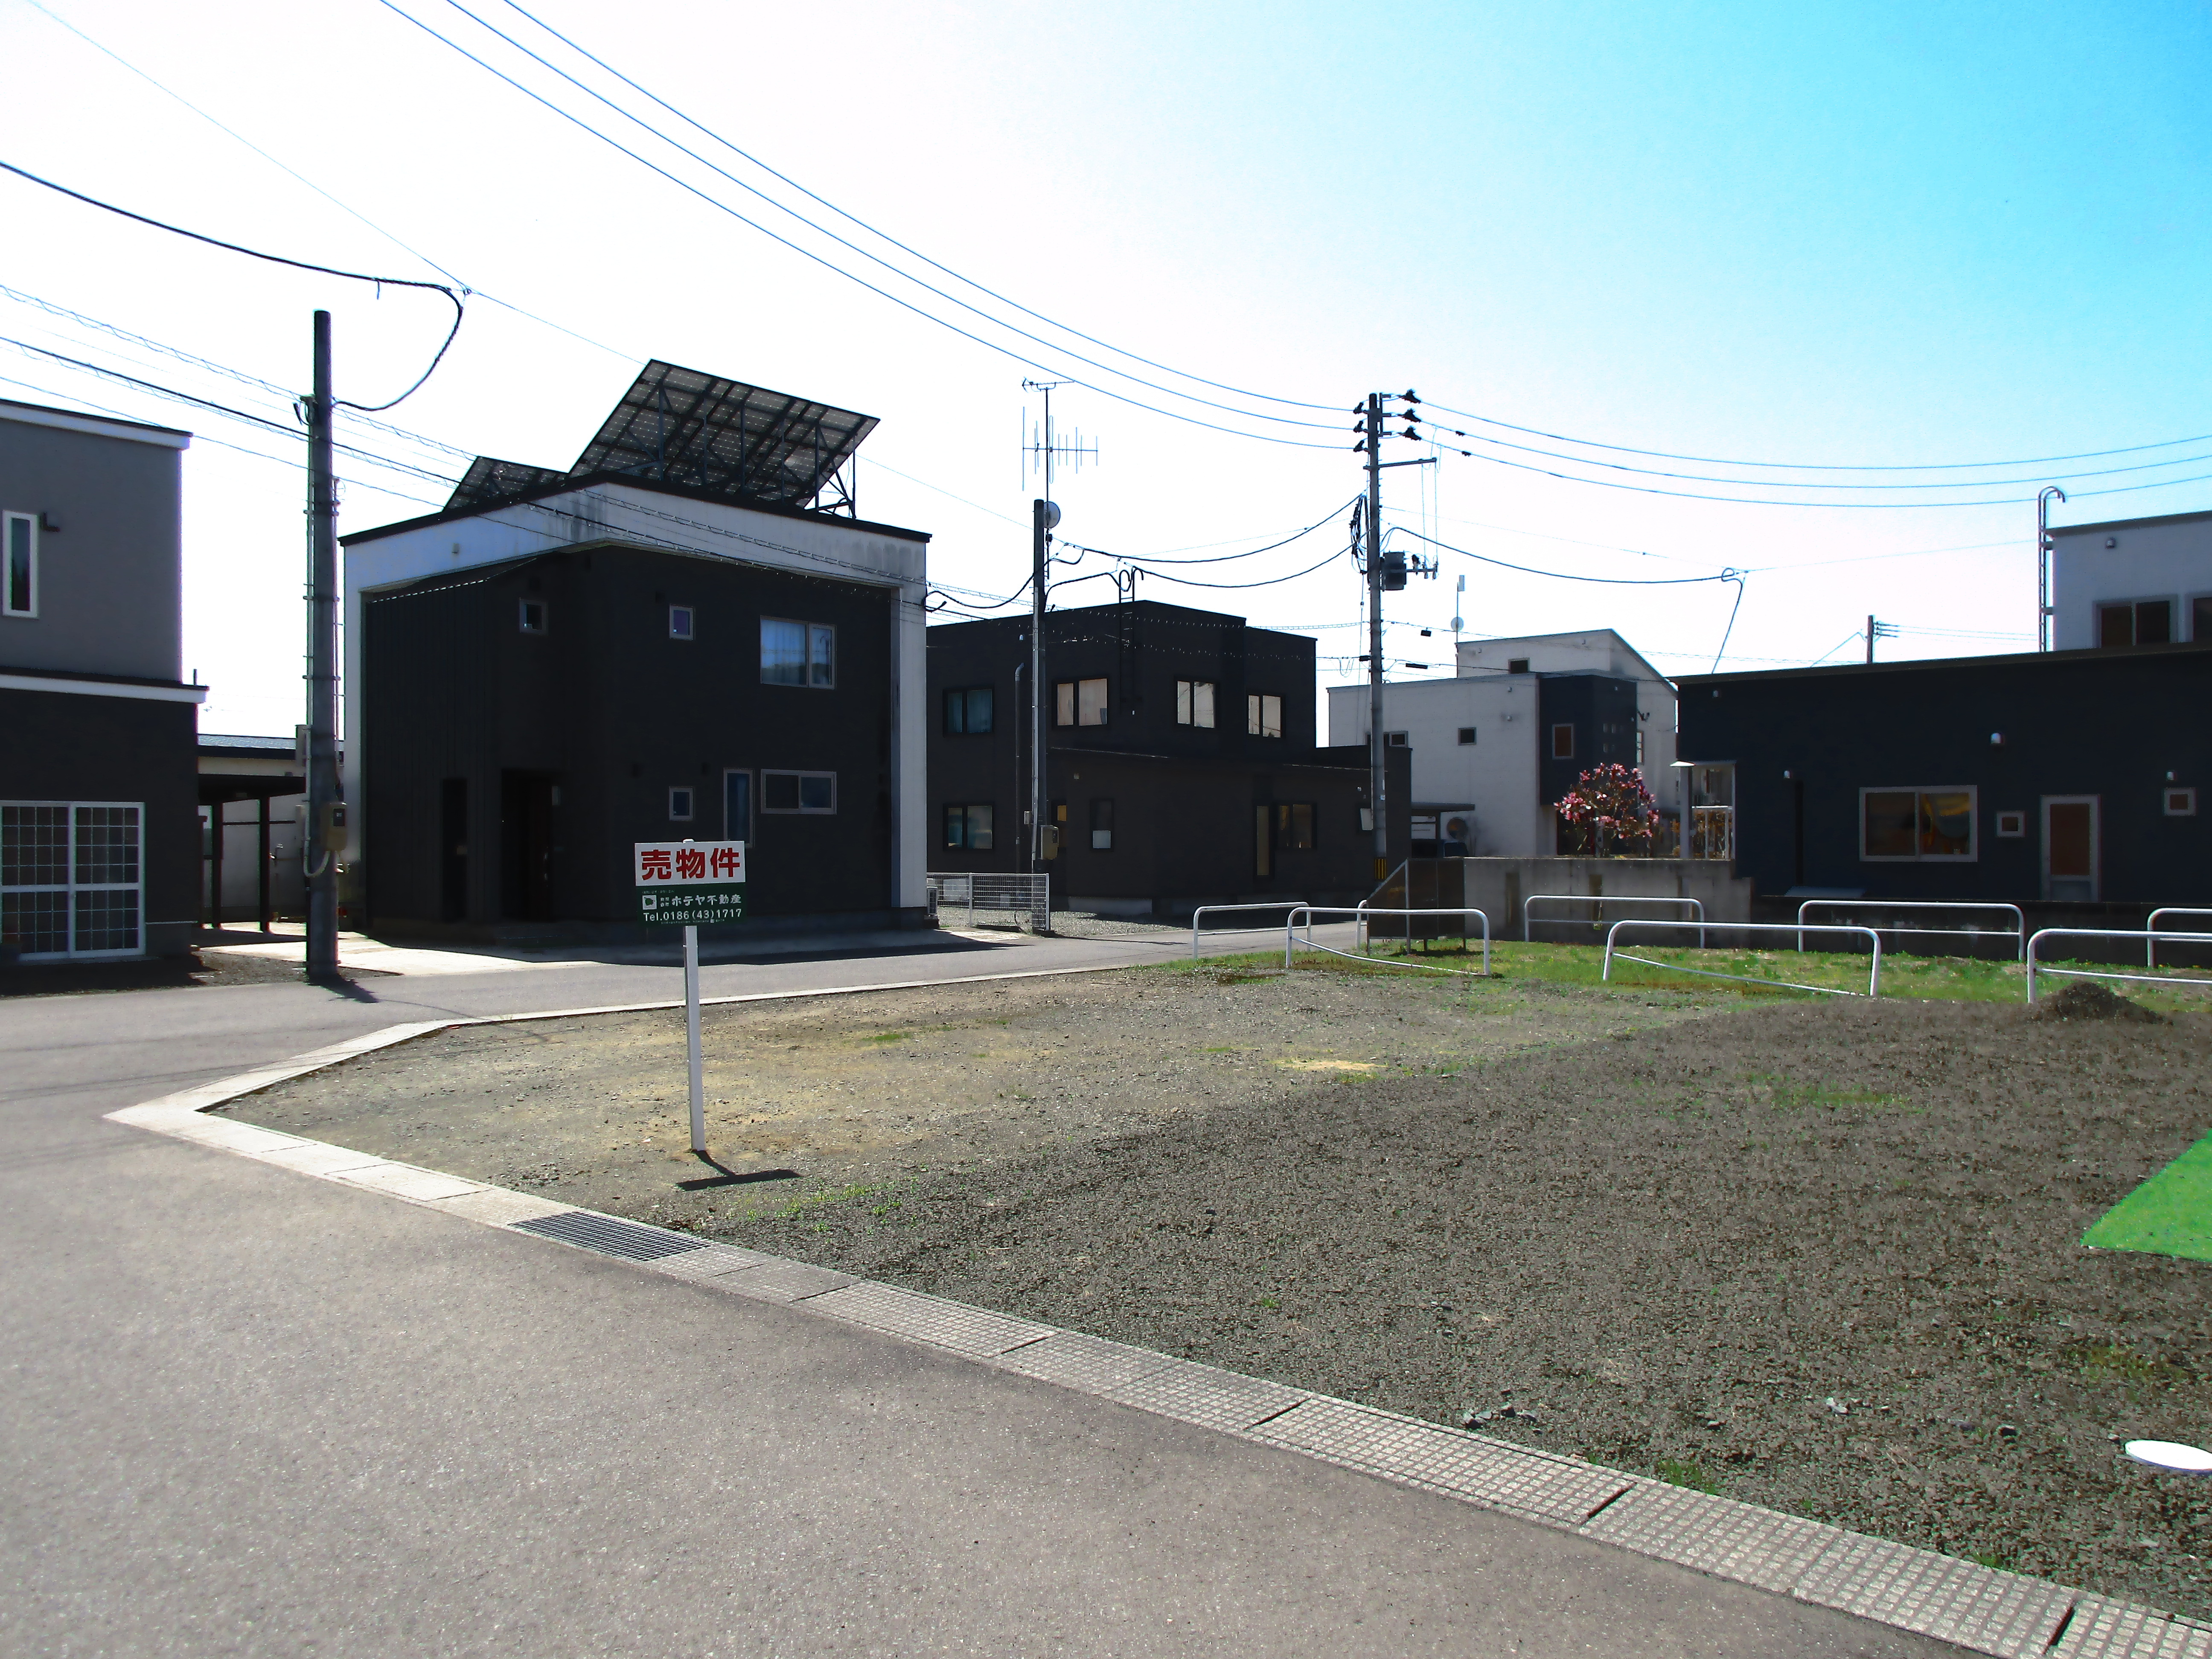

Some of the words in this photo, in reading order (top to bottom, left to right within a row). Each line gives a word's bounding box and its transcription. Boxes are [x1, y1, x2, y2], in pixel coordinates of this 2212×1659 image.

[640, 847, 741, 881] 売物件
[671, 894, 742, 907] ホテヤ不動産
